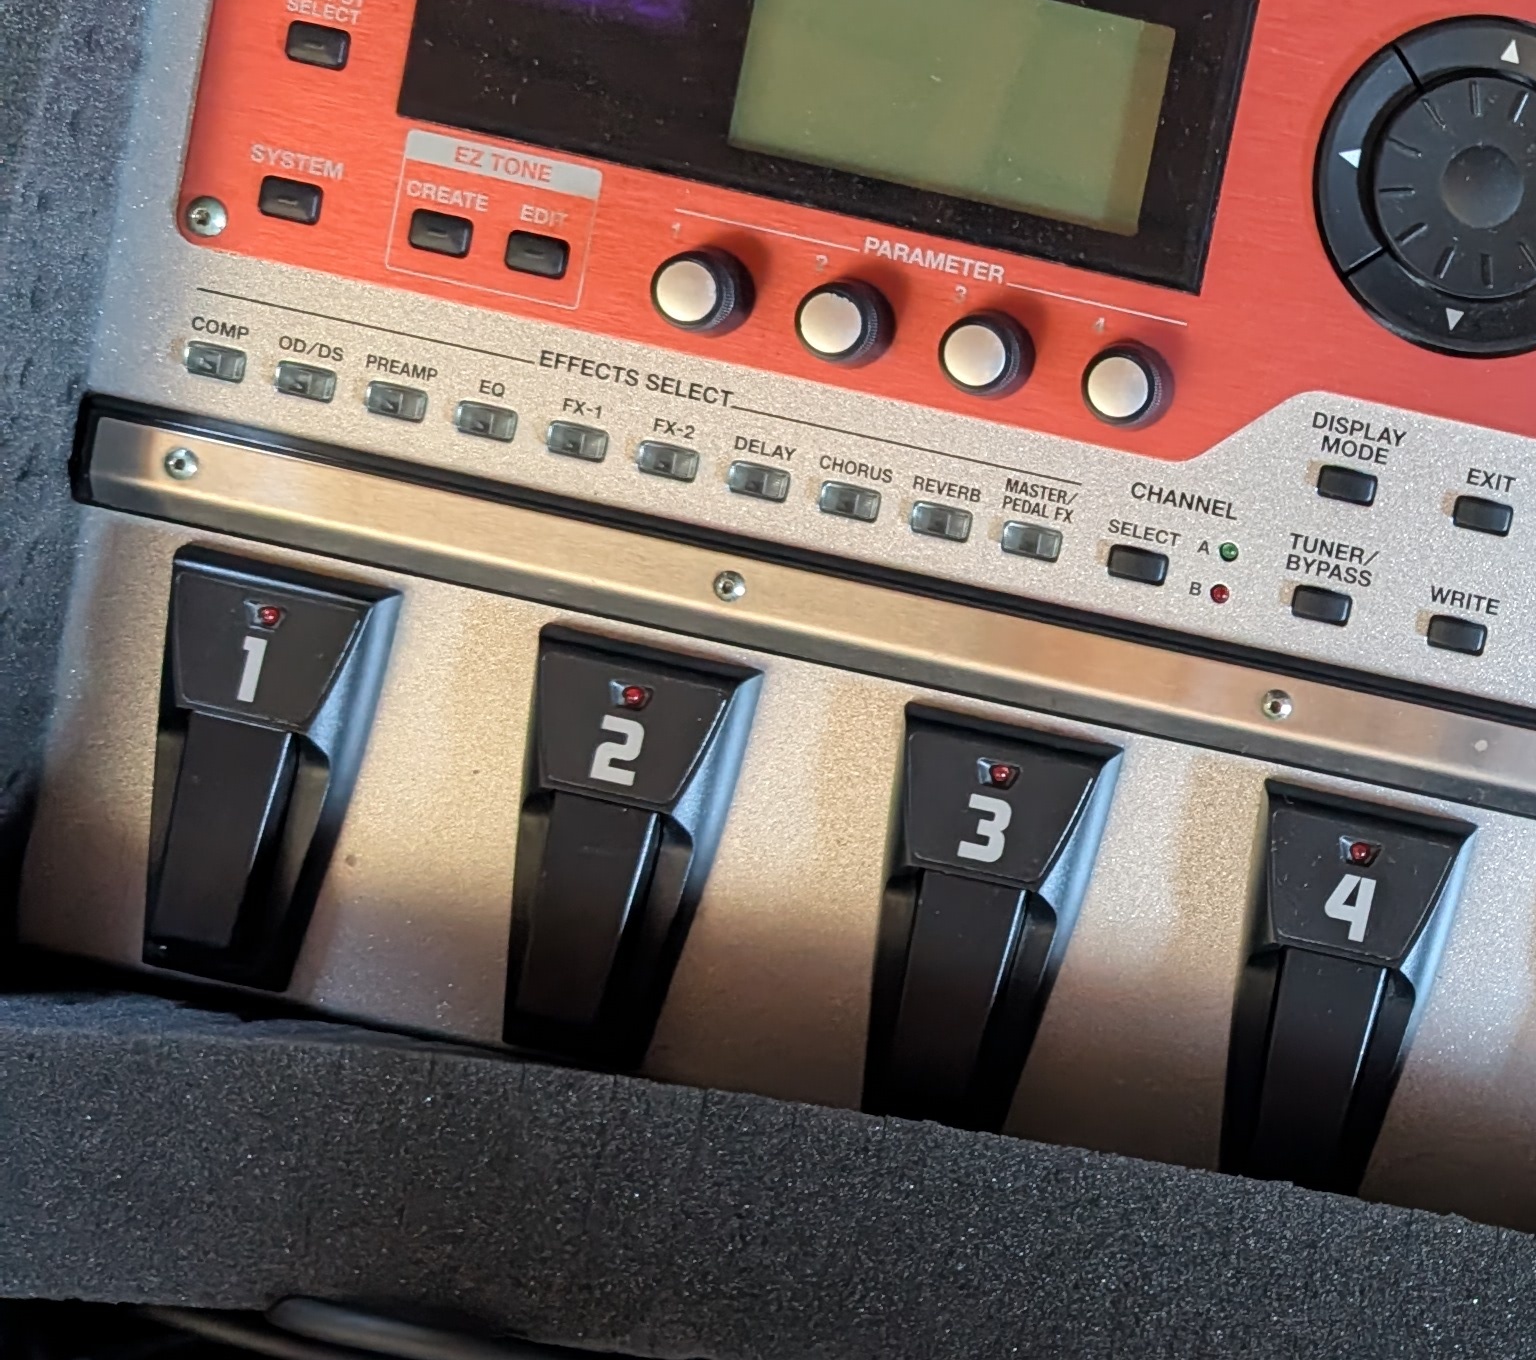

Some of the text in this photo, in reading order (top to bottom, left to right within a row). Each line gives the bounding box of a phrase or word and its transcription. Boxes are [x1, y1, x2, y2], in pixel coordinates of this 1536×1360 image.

[250, 143, 344, 180] SYSTEM
[454, 146, 553, 184] EZ TONE
[406, 180, 489, 213] CREATE
[519, 204, 569, 228] EDIT
[863, 237, 1006, 284] PARAMETER
[191, 316, 250, 341] COMP
[278, 335, 344, 363] OD/DS
[365, 354, 438, 382] PREAMP
[539, 350, 734, 408] EFFECTS SELECT
[479, 380, 506, 398] EQ
[562, 398, 603, 420] FX-1
[653, 418, 695, 440] FX-2
[1312, 411, 1408, 447] DISPLAY
[734, 436, 797, 462] DELAY
[1321, 437, 1390, 465] MODE
[819, 455, 894, 484] CHORUS
[1466, 469, 1516, 493] EXIT
[913, 475, 982, 503] REVERB
[1005, 477, 1078, 507] MASTER/
[1130, 482, 1238, 520] CHANNEL
[1002, 495, 1074, 524] PEDAL FX
[1107, 518, 1182, 547] SELECT
[1196, 540, 1210, 554] A
[1290, 533, 1380, 567] TUNER/
[1285, 554, 1373, 588] BYPASS
[1189, 581, 1201, 597] B
[1430, 585, 1500, 616] WRITE
[237, 636, 267, 703] 1
[590, 714, 645, 787] 2
[957, 793, 1013, 863] 3
[1324, 874, 1377, 943] 4
